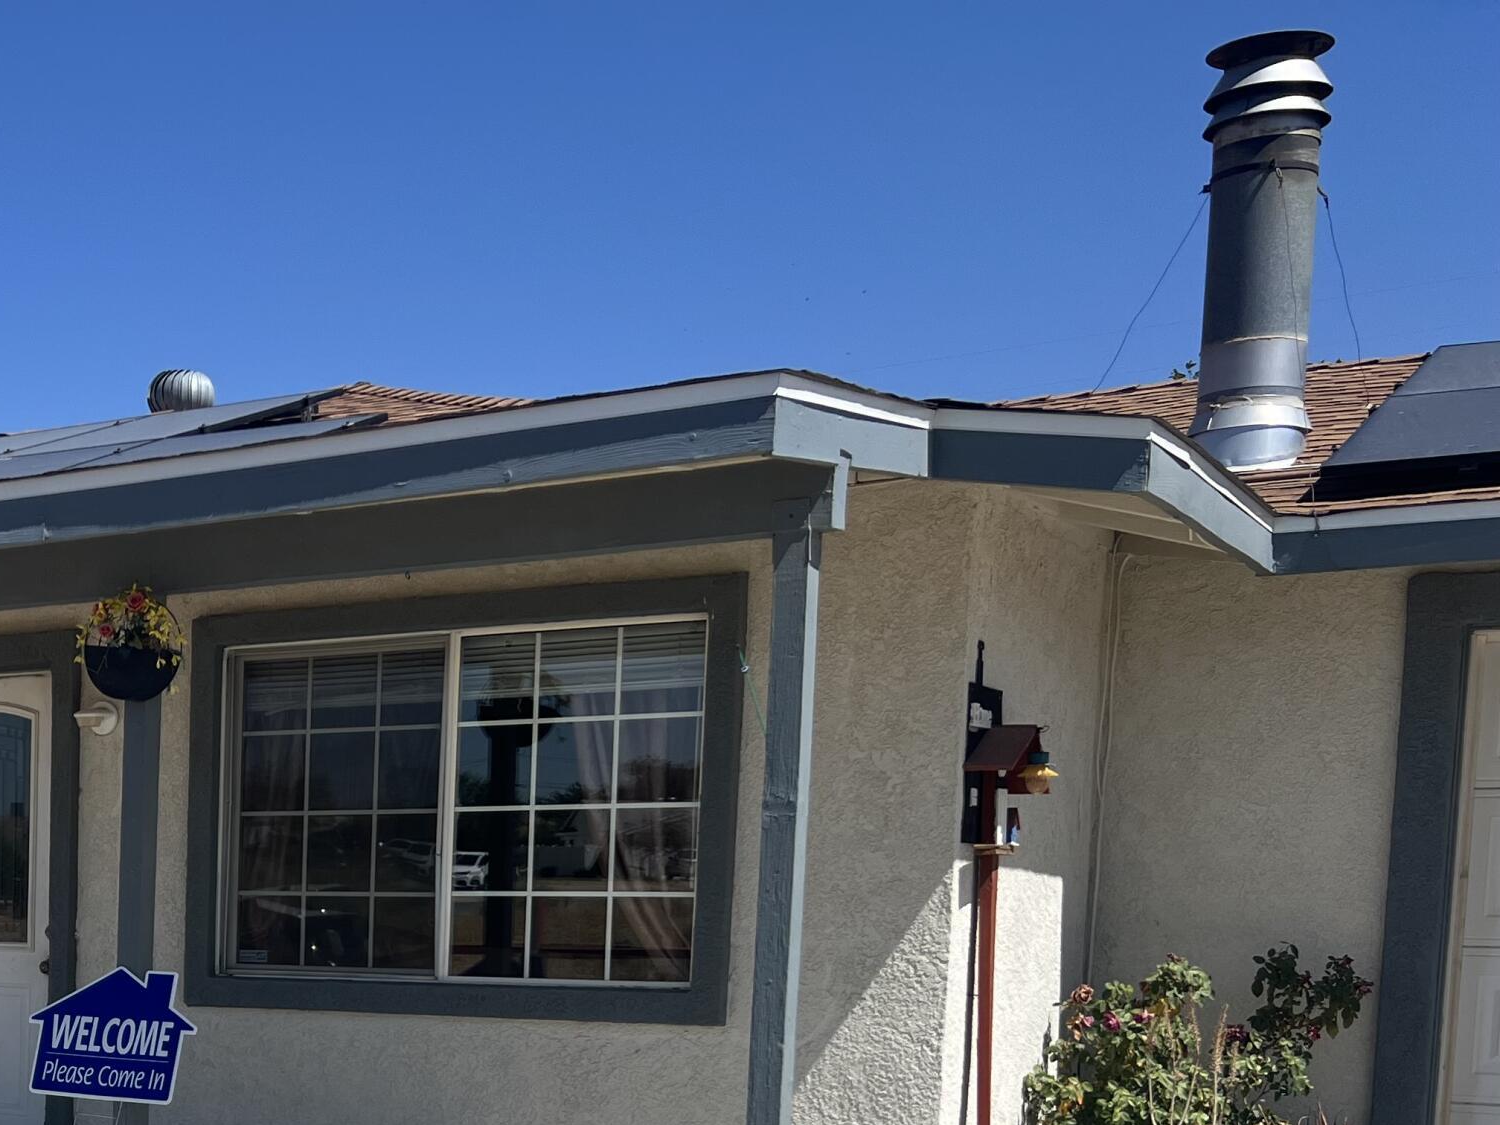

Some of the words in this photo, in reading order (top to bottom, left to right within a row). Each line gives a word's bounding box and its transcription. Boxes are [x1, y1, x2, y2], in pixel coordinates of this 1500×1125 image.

[51, 1013, 175, 1057] WELCOME
[41, 1058, 94, 1086] Please
[98, 1065, 145, 1089] Come
[148, 1069, 166, 1091] In
